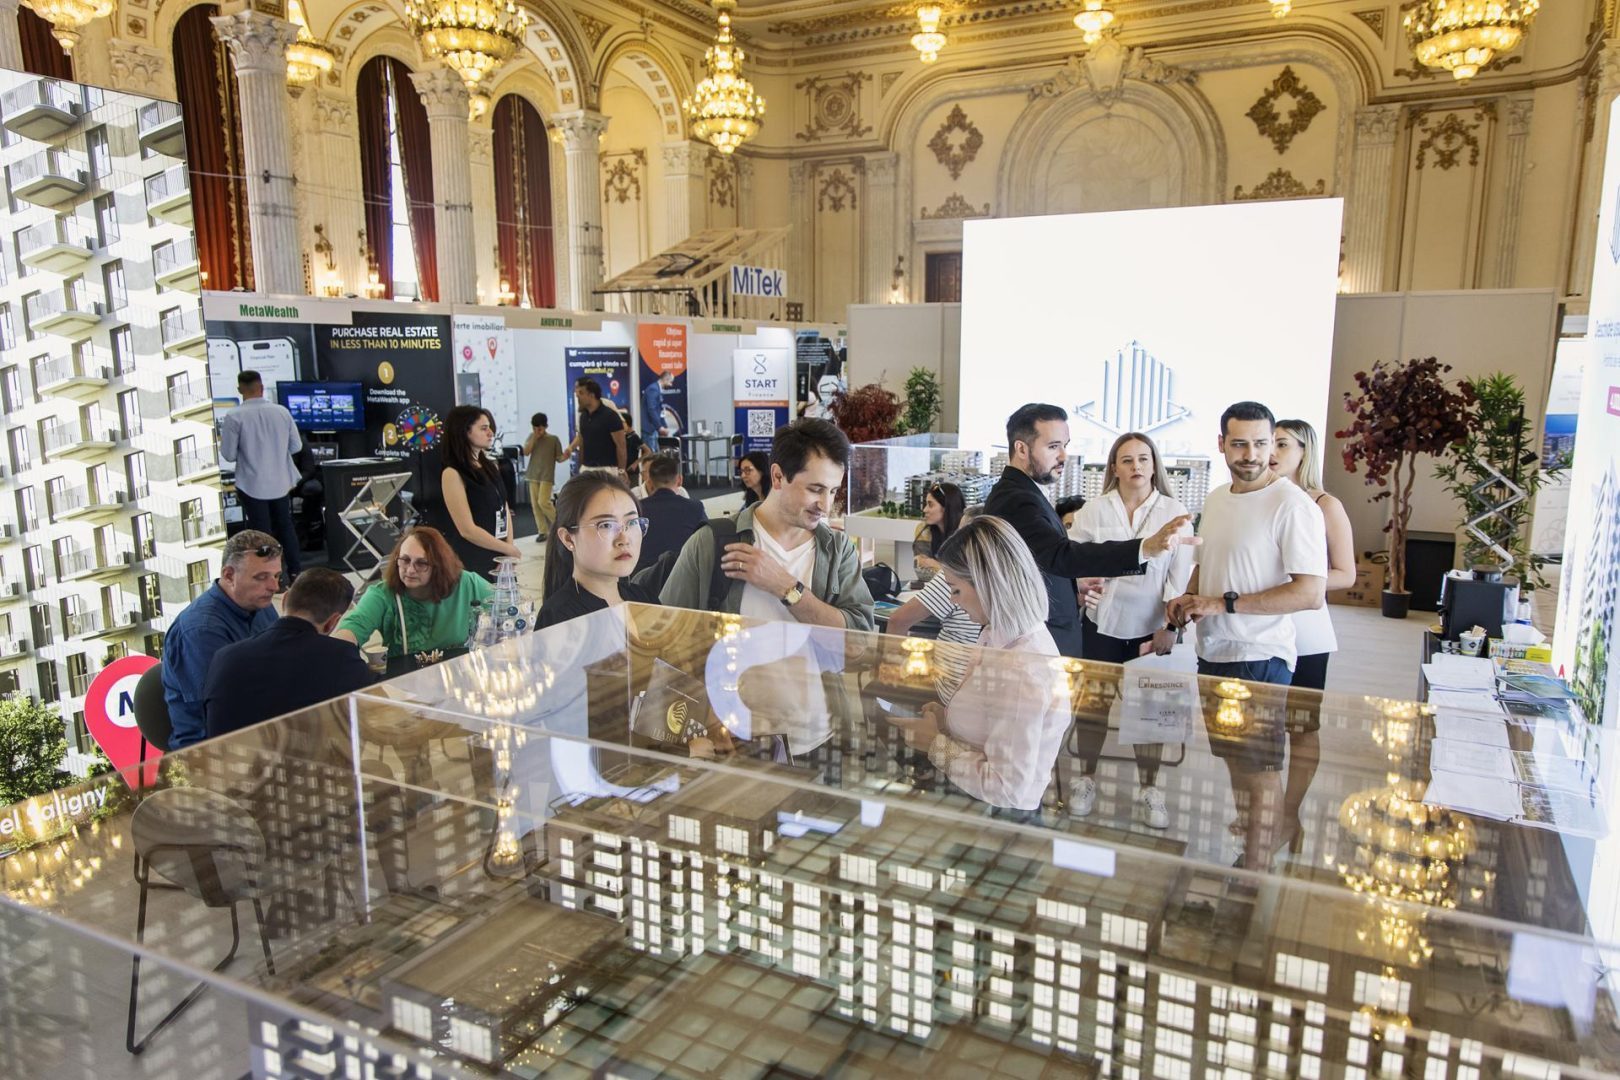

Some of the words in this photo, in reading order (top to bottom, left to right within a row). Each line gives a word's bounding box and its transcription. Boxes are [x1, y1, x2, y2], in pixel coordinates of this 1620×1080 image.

[733, 265, 783, 296] MiTek
[239, 304, 299, 318] MetaWealth
[332, 327, 378, 338] PURCHASE
[379, 327, 403, 338] REAL
[404, 326, 438, 337] ESTATE
[330, 340, 339, 349] IN
[341, 339, 361, 349] LESS
[363, 339, 388, 349] THAN
[390, 339, 399, 349] 10
[400, 338, 441, 349] MINUTES
[745, 379, 777, 388] START
